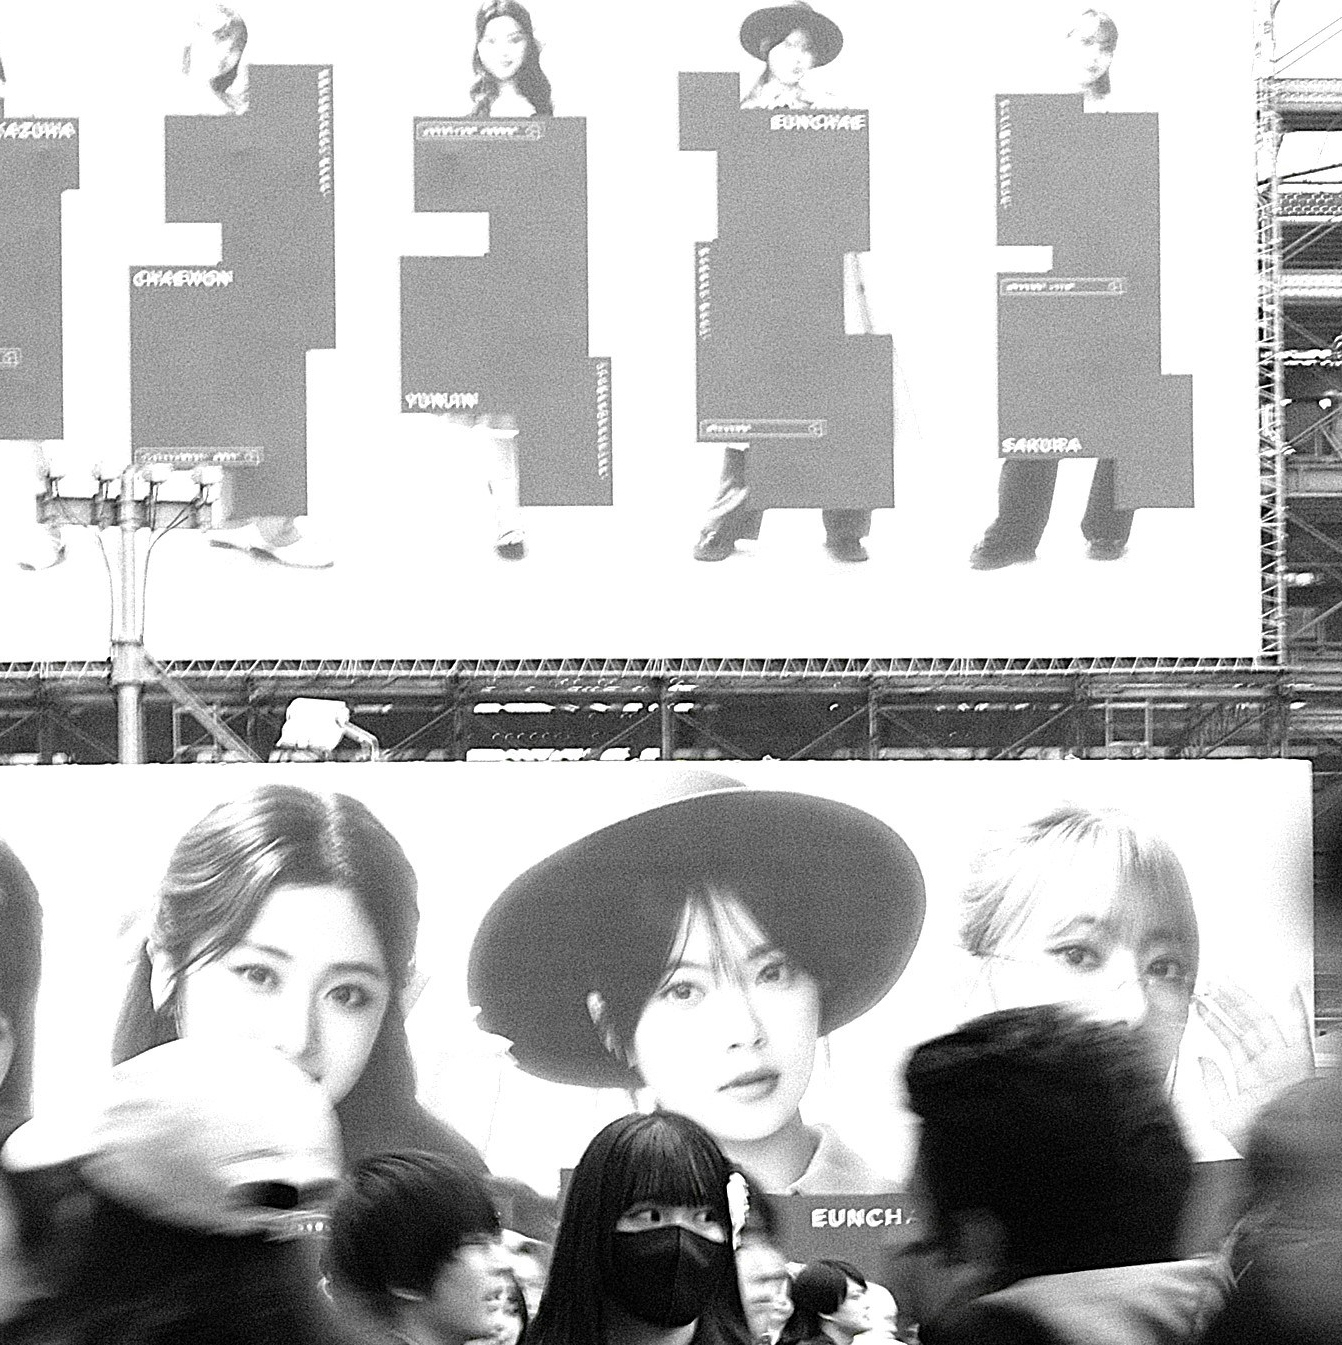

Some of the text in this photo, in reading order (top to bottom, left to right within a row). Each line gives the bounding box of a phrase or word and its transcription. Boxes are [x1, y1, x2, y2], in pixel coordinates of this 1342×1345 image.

[132, 266, 234, 287] CHAEWON
[1001, 437, 1082, 453] SAKURA
[810, 1207, 917, 1229] EUNCH
